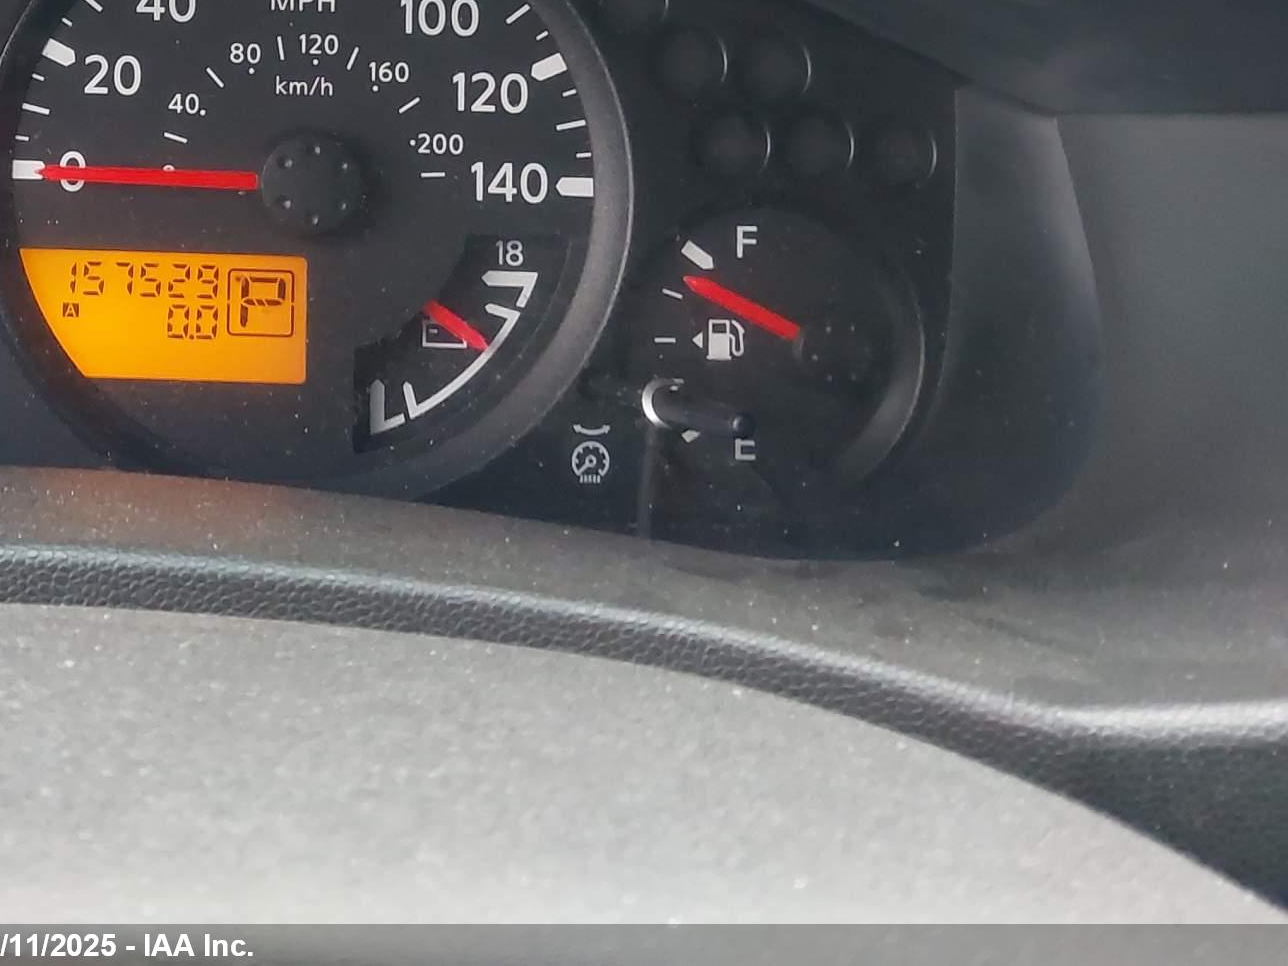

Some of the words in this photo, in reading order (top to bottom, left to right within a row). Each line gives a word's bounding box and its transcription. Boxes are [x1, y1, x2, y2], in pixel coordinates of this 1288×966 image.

[229, 42, 262, 65] 80
[298, 33, 340, 56] 120
[83, 54, 143, 97] 20
[274, 75, 334, 97] km/h
[368, 61, 410, 84] 160
[452, 72, 530, 114] 120
[417, 133, 465, 155] 200
[469, 161, 549, 204] 140
[495, 240, 525, 267] 18
[736, 225, 758, 259] F
[68, 260, 220, 300] 157529
[235, 276, 287, 329] P
[166, 303, 219, 341] 0.0
